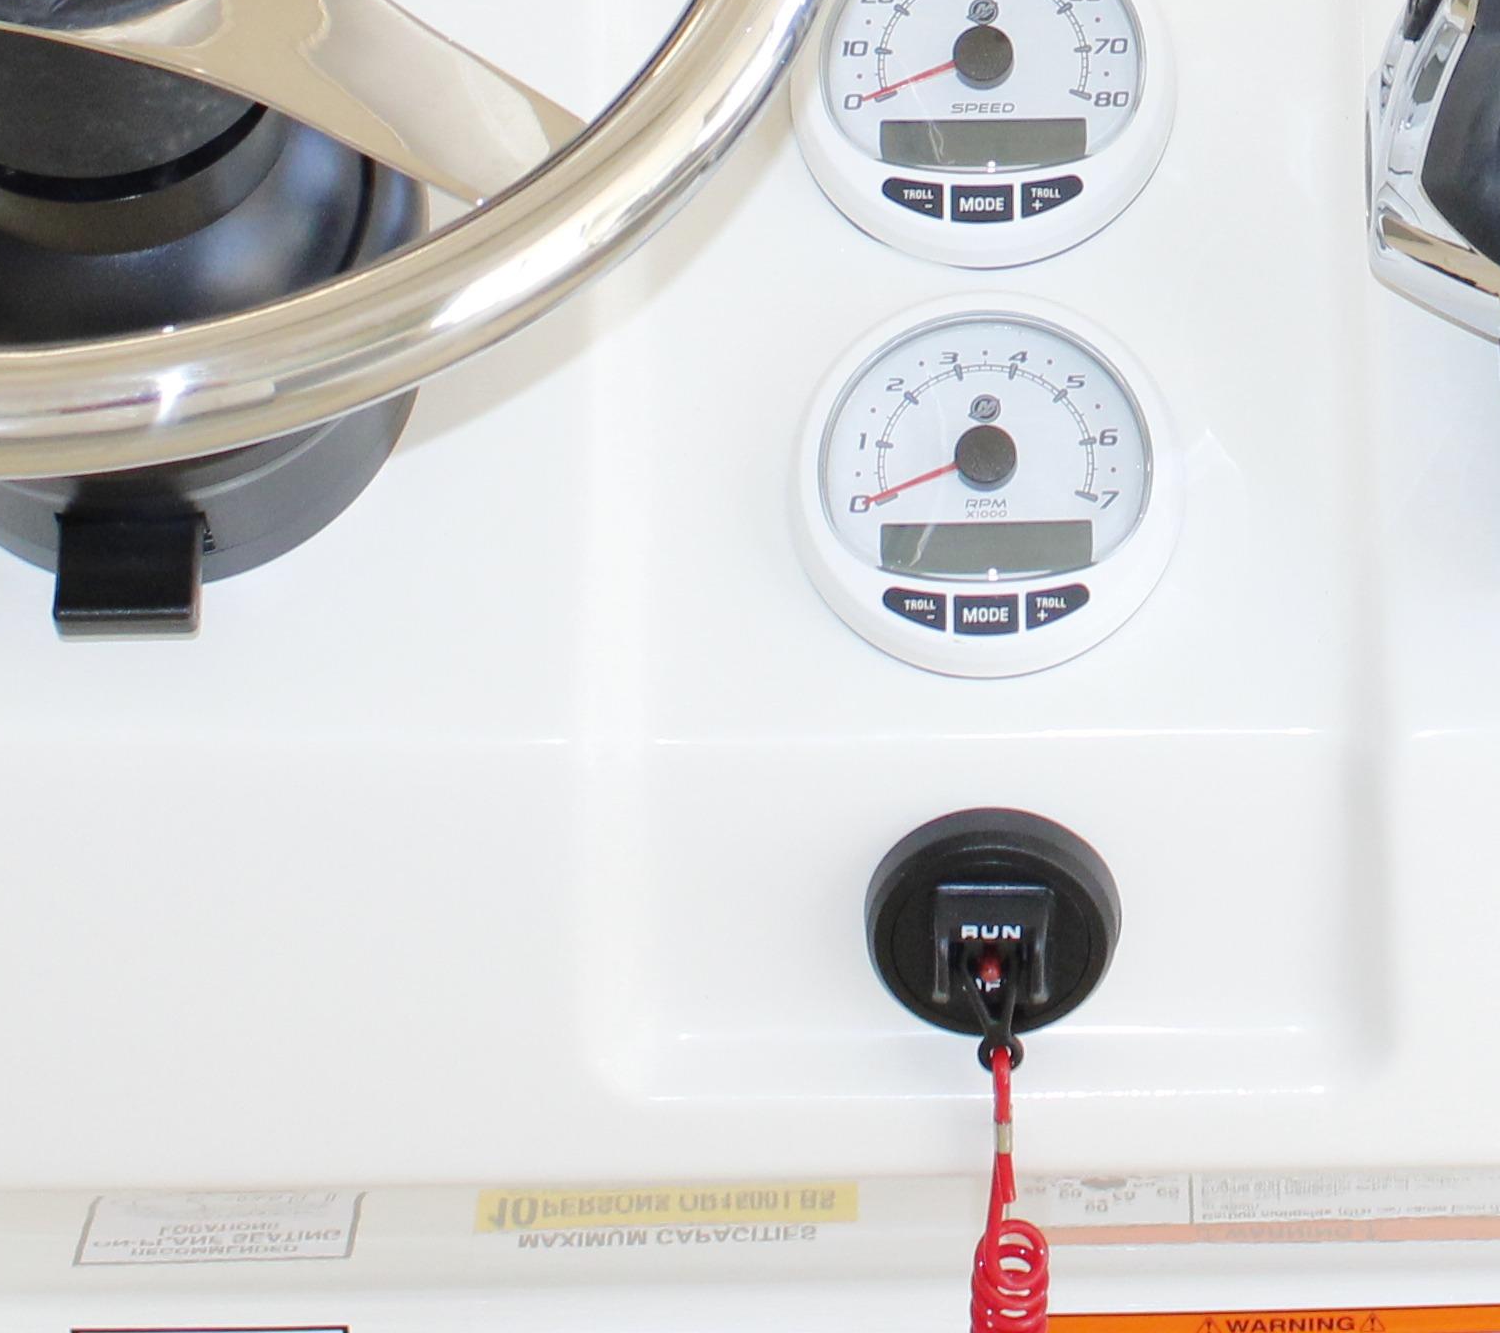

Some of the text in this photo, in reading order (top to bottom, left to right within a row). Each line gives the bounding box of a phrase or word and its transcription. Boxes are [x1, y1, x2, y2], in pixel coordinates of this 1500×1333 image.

[842, 40, 868, 57] 10
[1094, 38, 1129, 54] 70
[844, 93, 864, 110] 0
[950, 101, 1016, 114] SPEED
[1094, 92, 1129, 108] 80
[902, 188, 934, 200] TROLL
[1031, 187, 1061, 199] TROLL
[959, 196, 1005, 212] MODE
[940, 352, 958, 365] 3
[1008, 351, 1028, 364] 4
[886, 378, 905, 392] 2
[1067, 375, 1086, 389] 5
[857, 433, 867, 450] 1
[1099, 429, 1119, 446] 6
[965, 498, 1007, 509] RPM
[1099, 491, 1120, 510] 7
[965, 510, 1007, 518] X1000
[904, 598, 936, 611] TROLL
[1035, 597, 1067, 609] TROLL
[962, 606, 1009, 623] MODE
[960, 924, 1022, 940] RUN
[1226, 1317, 1356, 1333] WARNING
